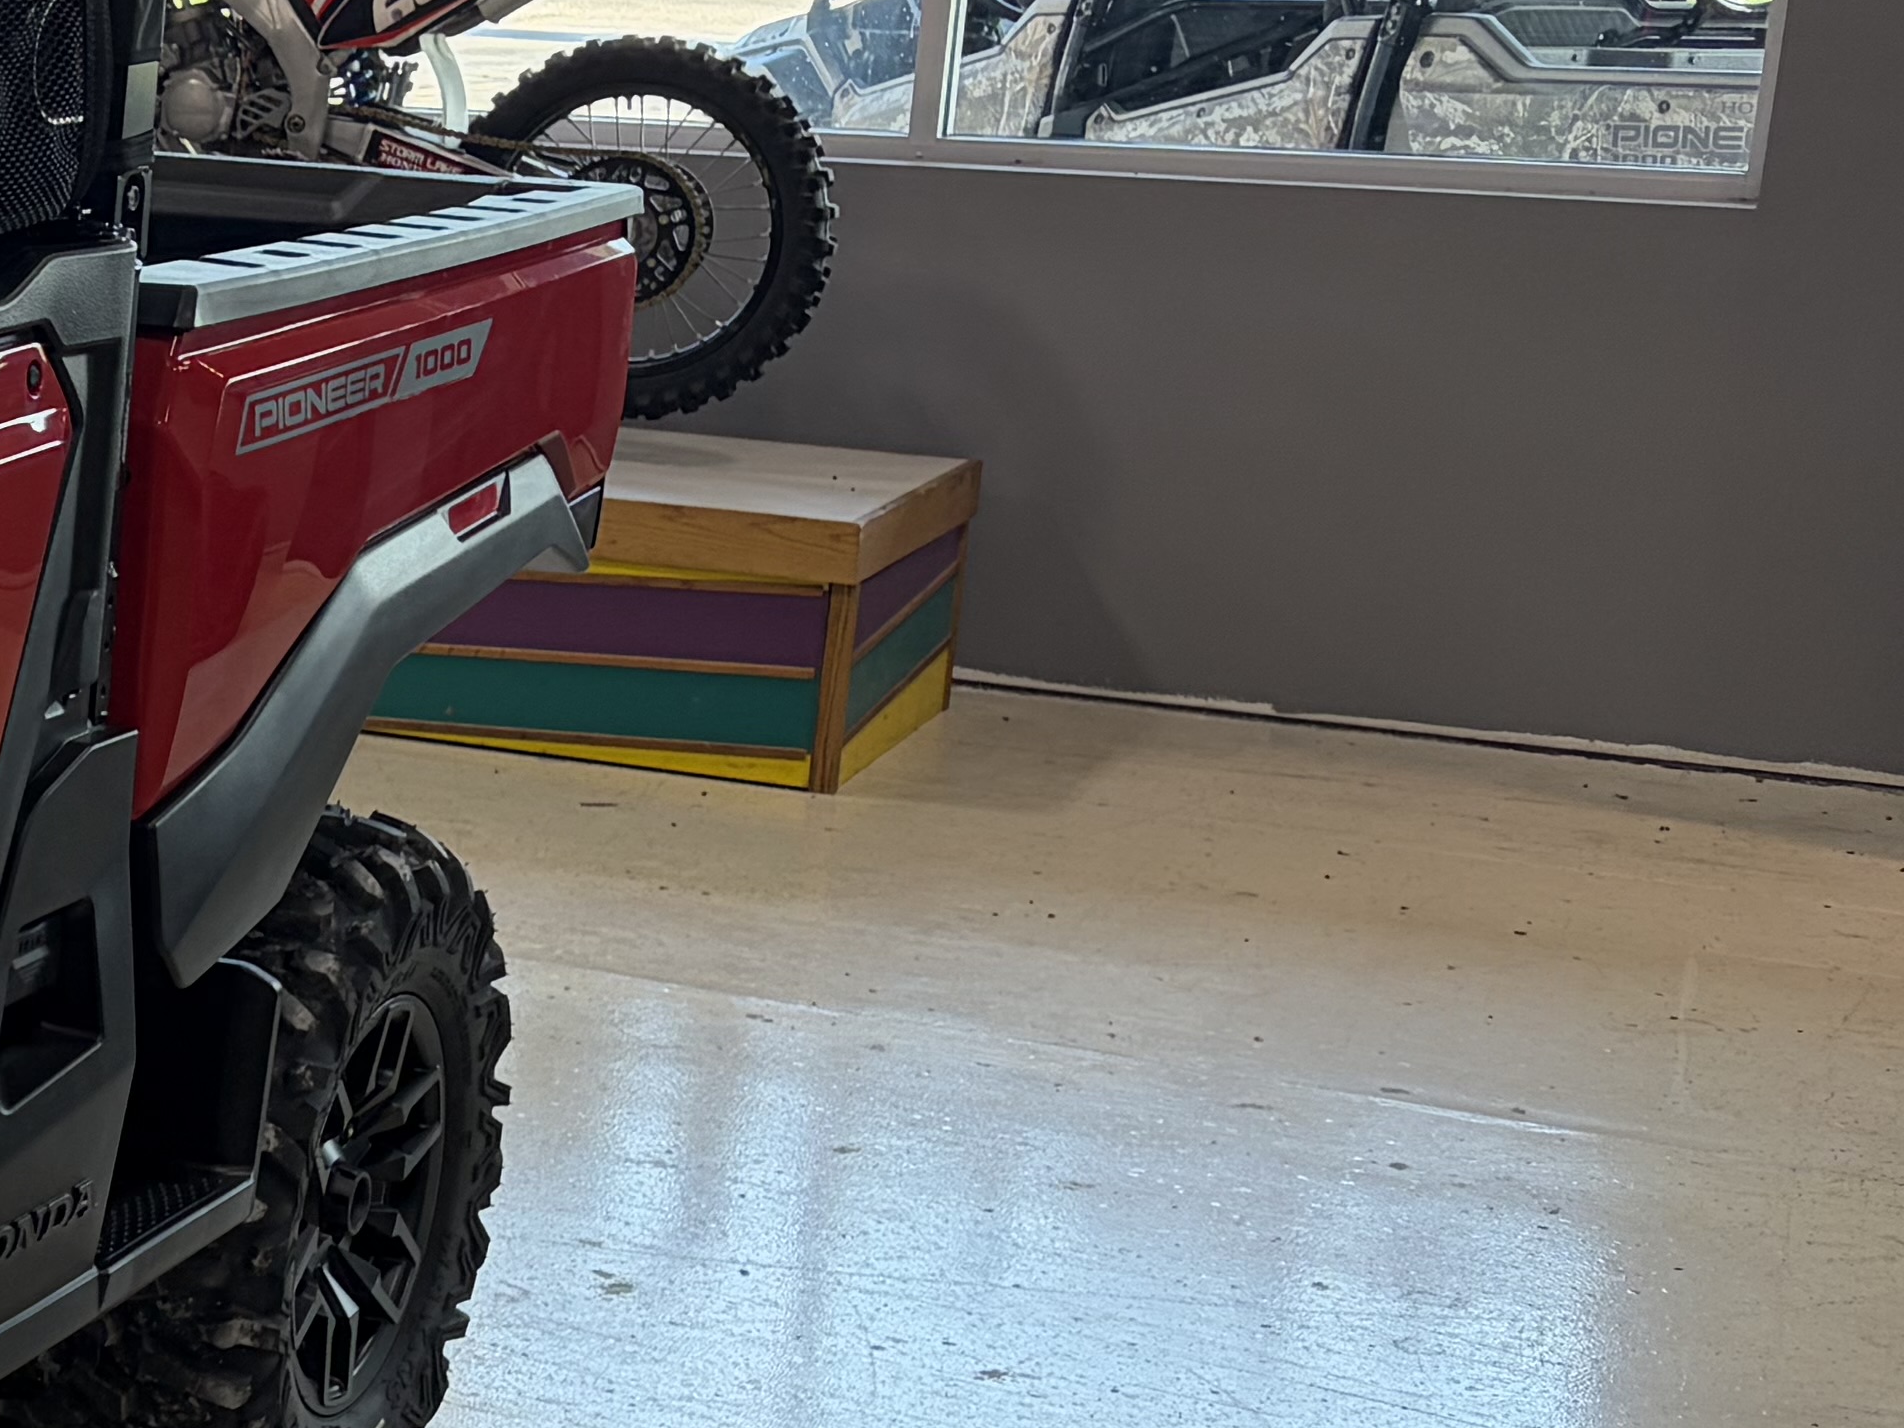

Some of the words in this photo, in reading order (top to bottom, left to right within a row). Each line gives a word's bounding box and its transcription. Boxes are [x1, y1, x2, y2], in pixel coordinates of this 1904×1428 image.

[1611, 123, 1752, 151] PIONE
[379, 139, 425, 165] STORM
[254, 363, 386, 438] PIONEER
[415, 337, 473, 380] 1000
